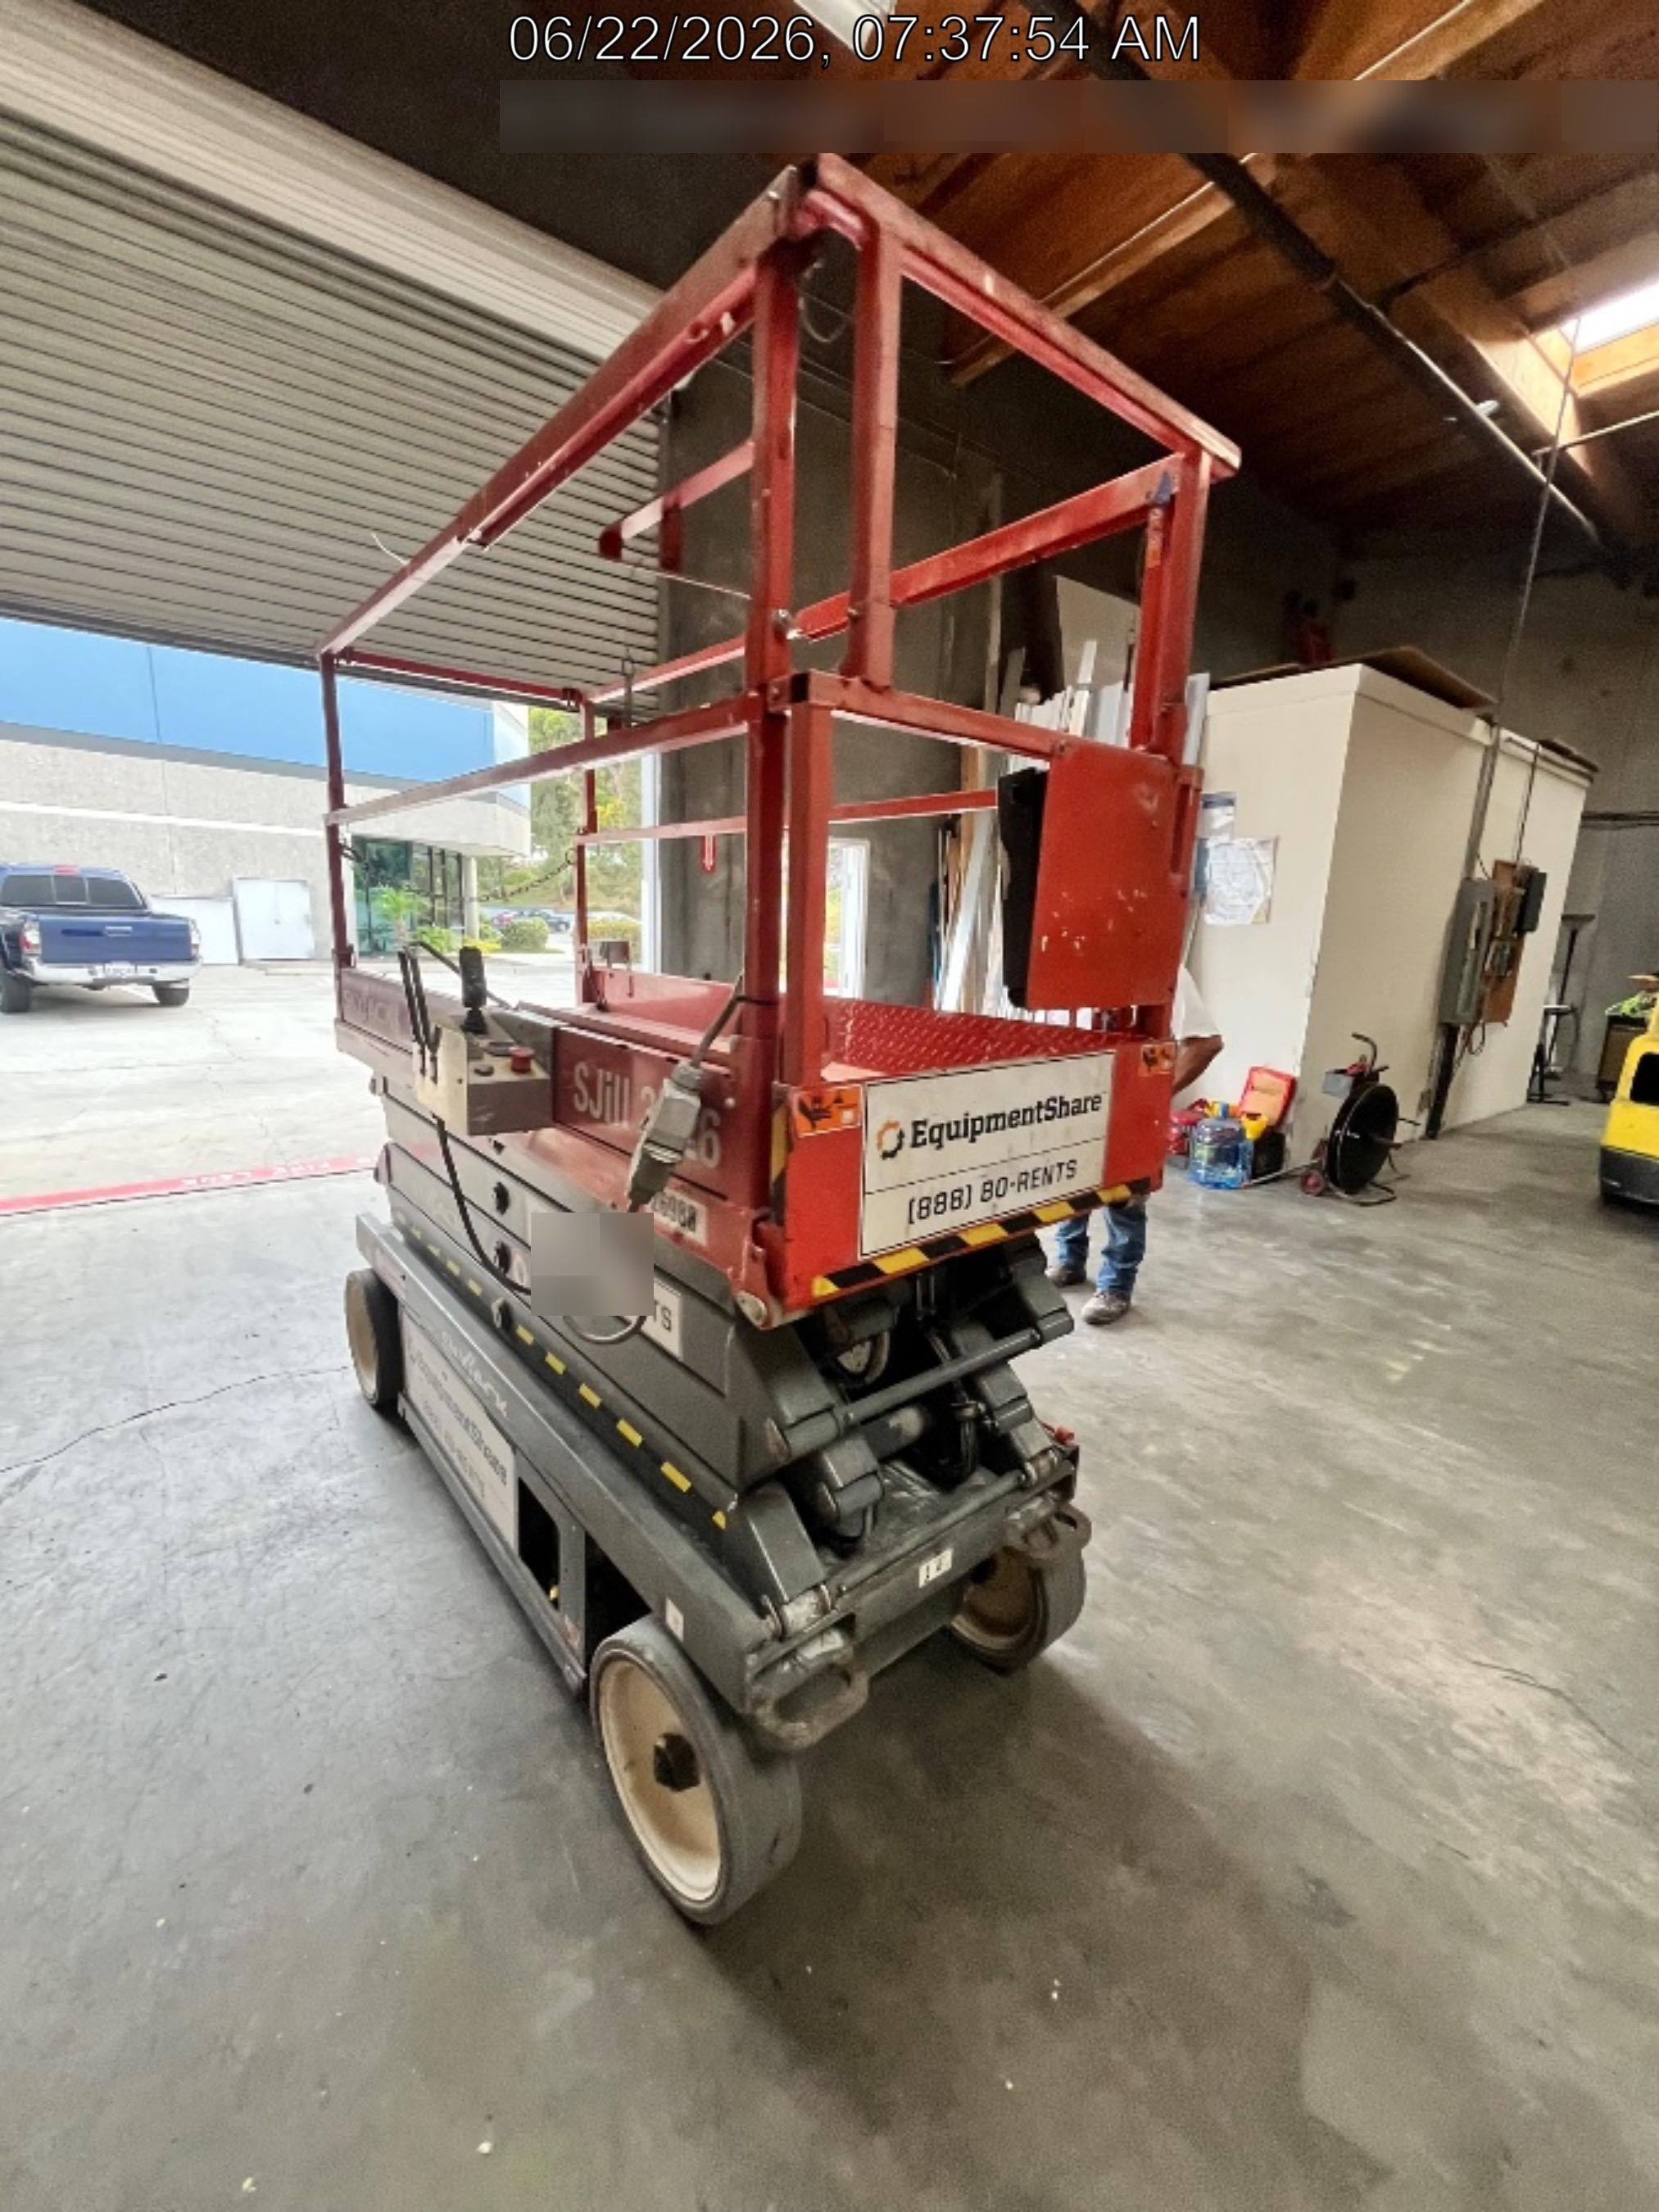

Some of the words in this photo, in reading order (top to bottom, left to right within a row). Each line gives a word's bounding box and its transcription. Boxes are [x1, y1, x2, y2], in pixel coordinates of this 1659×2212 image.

[910, 1094, 1103, 1150] EquipmentShare
[909, 1185, 972, 1224] (888)
[981, 1159, 1077, 1203] 80-RENTS
